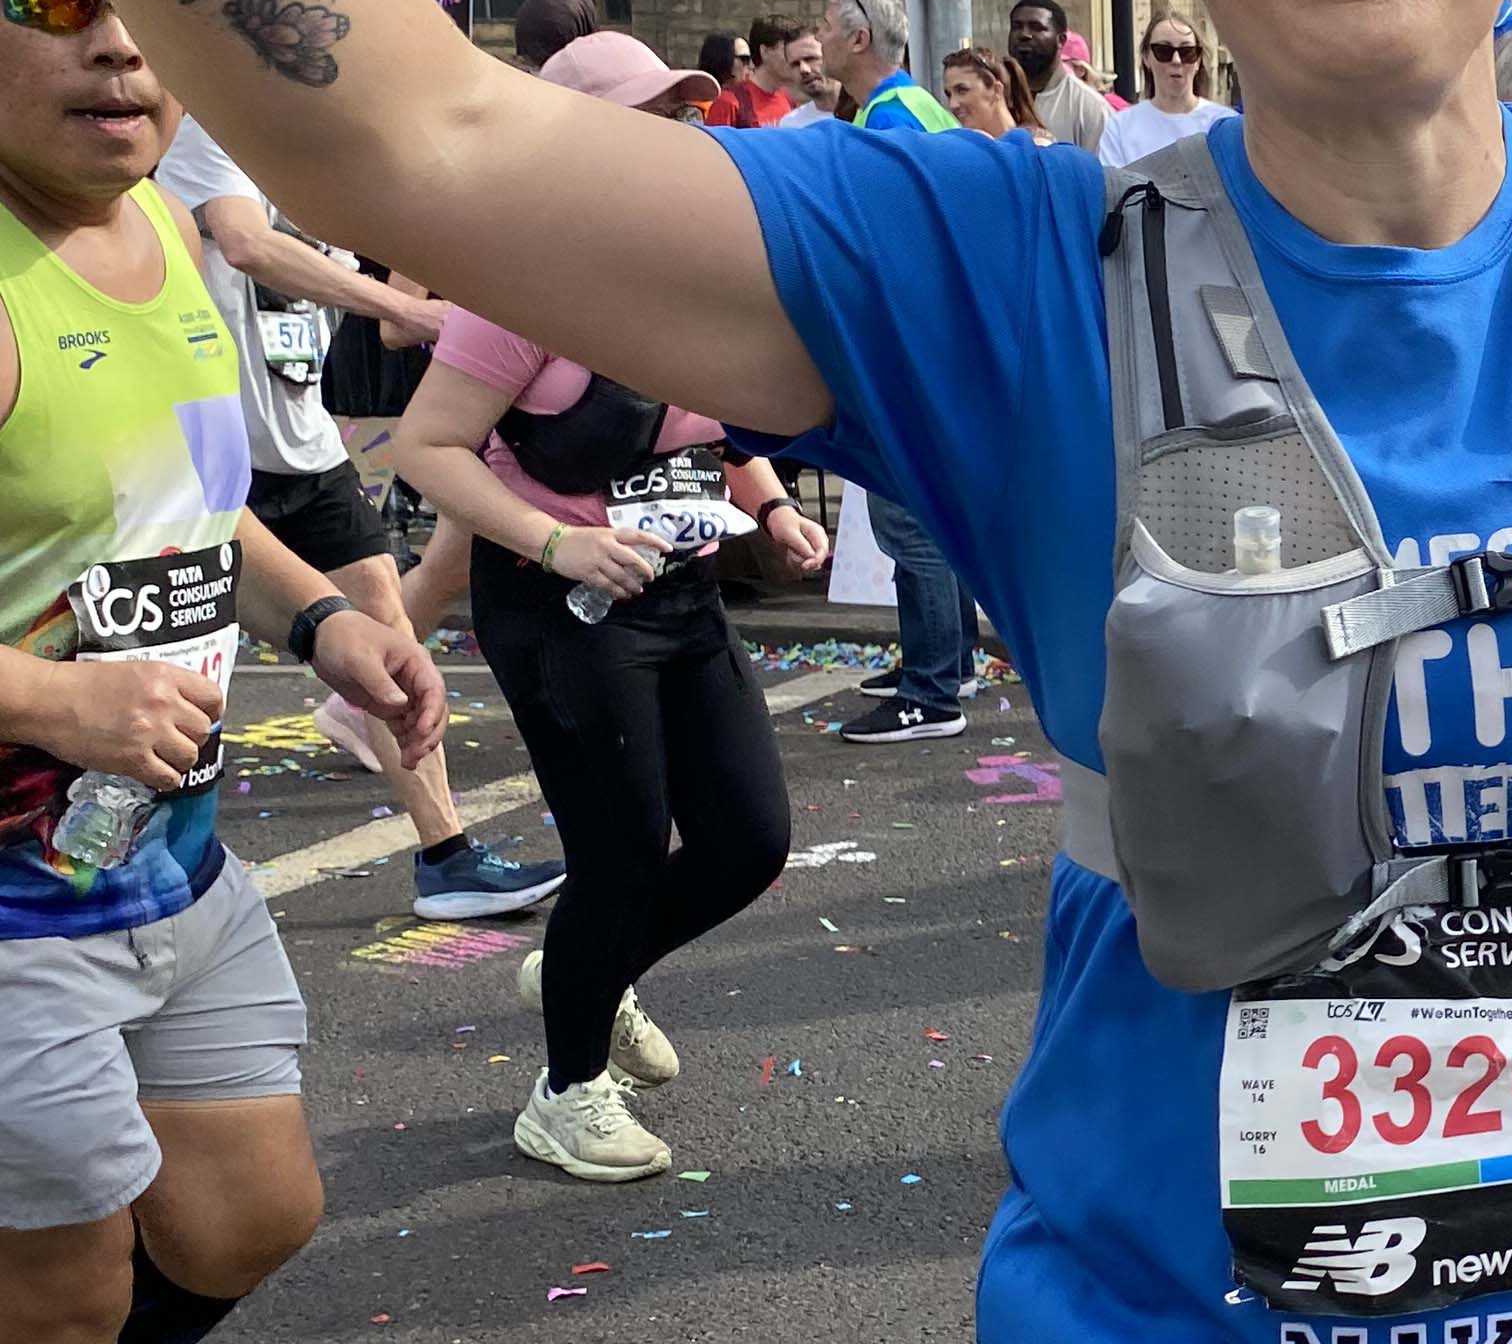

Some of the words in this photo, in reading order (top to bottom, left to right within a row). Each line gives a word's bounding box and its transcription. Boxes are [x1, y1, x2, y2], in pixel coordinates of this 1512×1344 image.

[58, 330, 111, 350] BROOKS
[610, 467, 668, 499] tcs
[671, 470, 722, 483] CONSULTANCY
[672, 482, 702, 494] SERVICES
[168, 565, 203, 587] TATA
[169, 575, 233, 607] CONSULTANCY
[170, 601, 217, 628] SERVICES
[1327, 1001, 1353, 1018] tcs
[1242, 1079, 1275, 1090] WAVE
[1251, 1093, 1265, 1103] 14
[1240, 1131, 1278, 1142] LORRY
[1252, 1145, 1266, 1154] 16
[1323, 1176, 1378, 1194] MEDAL
